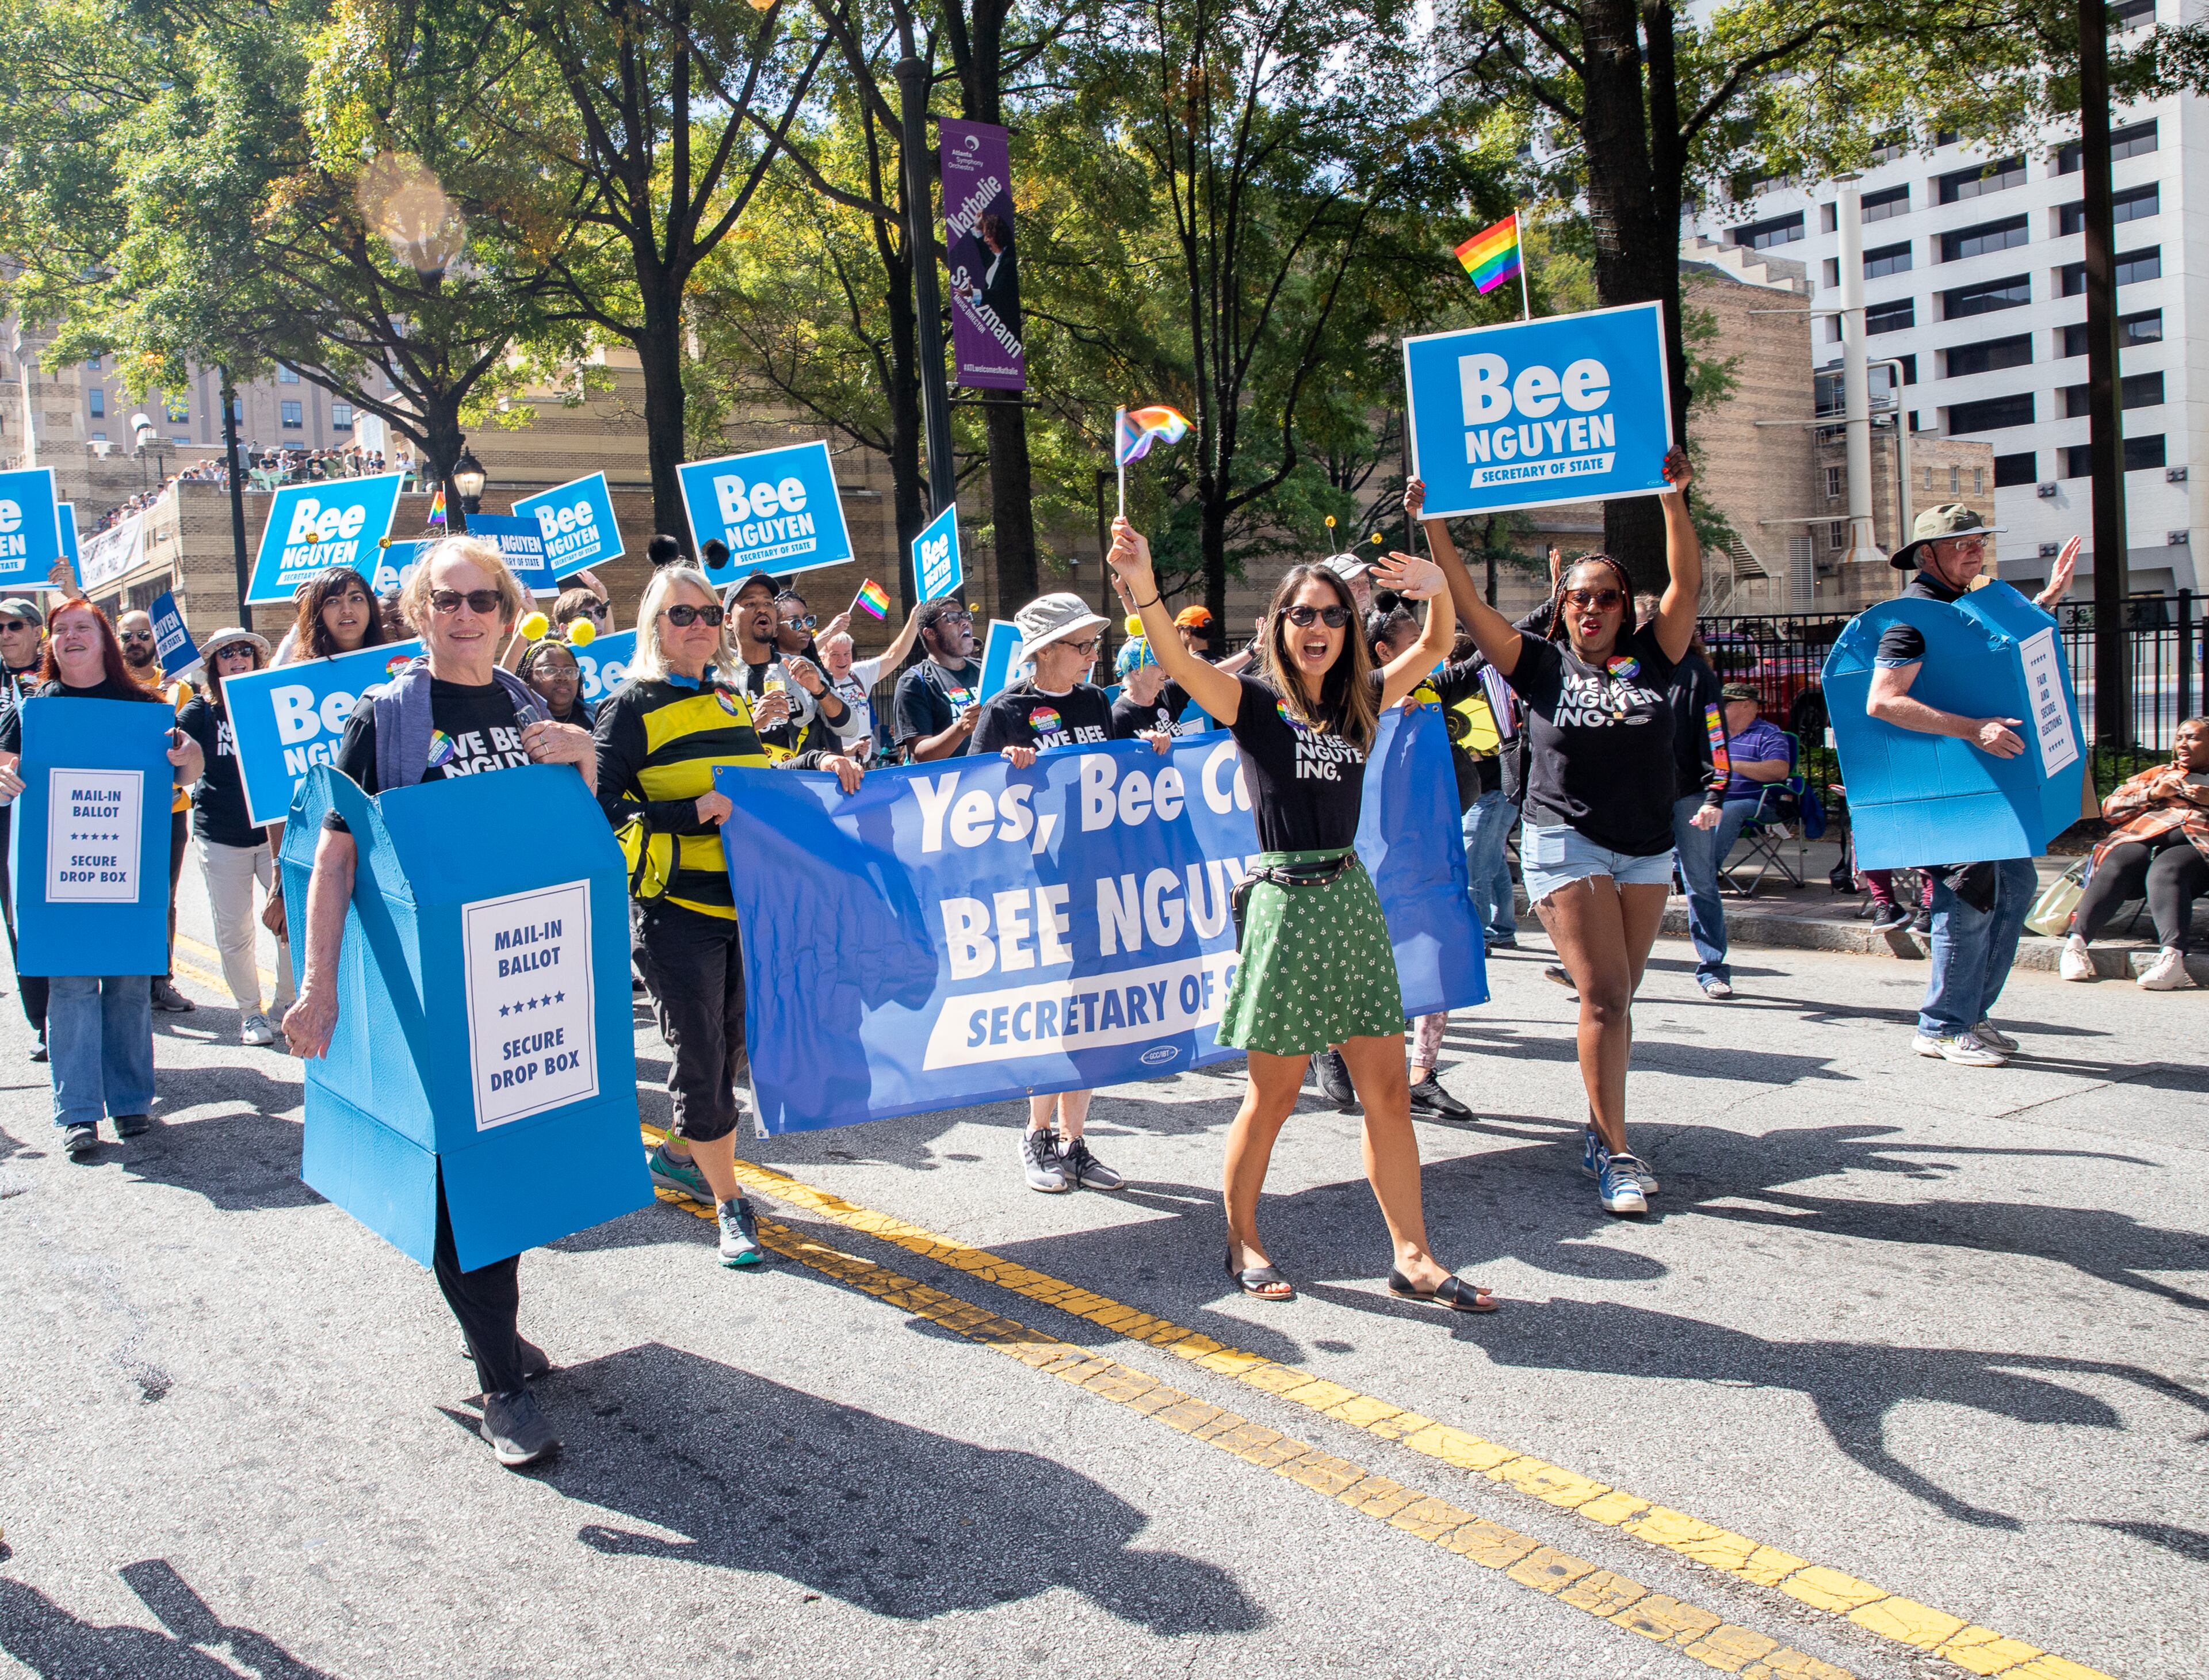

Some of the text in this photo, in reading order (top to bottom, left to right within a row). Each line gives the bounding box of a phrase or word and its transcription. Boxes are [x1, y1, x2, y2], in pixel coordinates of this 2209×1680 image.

[952, 149, 973, 158] Atlanta
[956, 156, 984, 167] Symphony
[948, 162, 974, 171] Orchestra
[946, 175, 1002, 239] Nathalie
[953, 294, 987, 334] MUSIC DIRECTOR
[964, 363, 1019, 375] #ATLwelcomesNathalie
[1458, 353, 1611, 426] Bee
[1465, 413, 1616, 464] NGUYEN
[1482, 458, 1604, 483] SECRETARY OF STATE
[713, 474, 807, 525] Bee
[286, 498, 366, 545] Bee
[534, 501, 594, 541] Bee
[725, 512, 816, 551] NGUYEN
[500, 534, 542, 552] NGUYEN
[544, 524, 600, 559] NGUYEN
[740, 542, 811, 563] SECRETARY OF STATE
[280, 540, 359, 570] NGUYEN
[517, 558, 523, 566] OF
[525, 558, 540, 566] STATE
[554, 553, 577, 567] SECRETARY
[585, 545, 597, 554] STATE
[921, 533, 948, 575] Bee
[284, 571, 316, 581] SECRETARY
[924, 555, 951, 590] NGUYEN
[168, 634, 182, 648] STATE
[1563, 674, 1599, 692] WE
[2036, 673, 2047, 687] FAIR
[1557, 688, 1664, 712] NGUYEN
[2040, 688, 2050, 702] AND
[270, 684, 387, 746] Be
[1553, 708, 1615, 728] ING.
[2040, 701, 2057, 719] SECURE
[1293, 727, 1324, 745] WE
[2042, 714, 2062, 736] ELECTIONS
[1033, 726, 1107, 750] WE BEE
[1295, 742, 1366, 764] NGUYE
[1296, 760, 1342, 782] ING.
[71, 790, 121, 801] MAIL-IN
[909, 771, 1058, 854] Yes,
[1080, 753, 1184, 832] Bee
[73, 806, 119, 818] BALLOT
[71, 856, 117, 866] SECURE
[60, 871, 127, 882] DROP BOX
[495, 919, 562, 951] MAIL-IN
[939, 884, 1073, 981] BEE
[498, 946, 560, 978] BALLOT
[967, 980, 1168, 1047] SECRETARY
[1179, 969, 1213, 1014] OF
[503, 1028, 564, 1060] SECURE
[491, 1049, 580, 1091] DROP BOX
